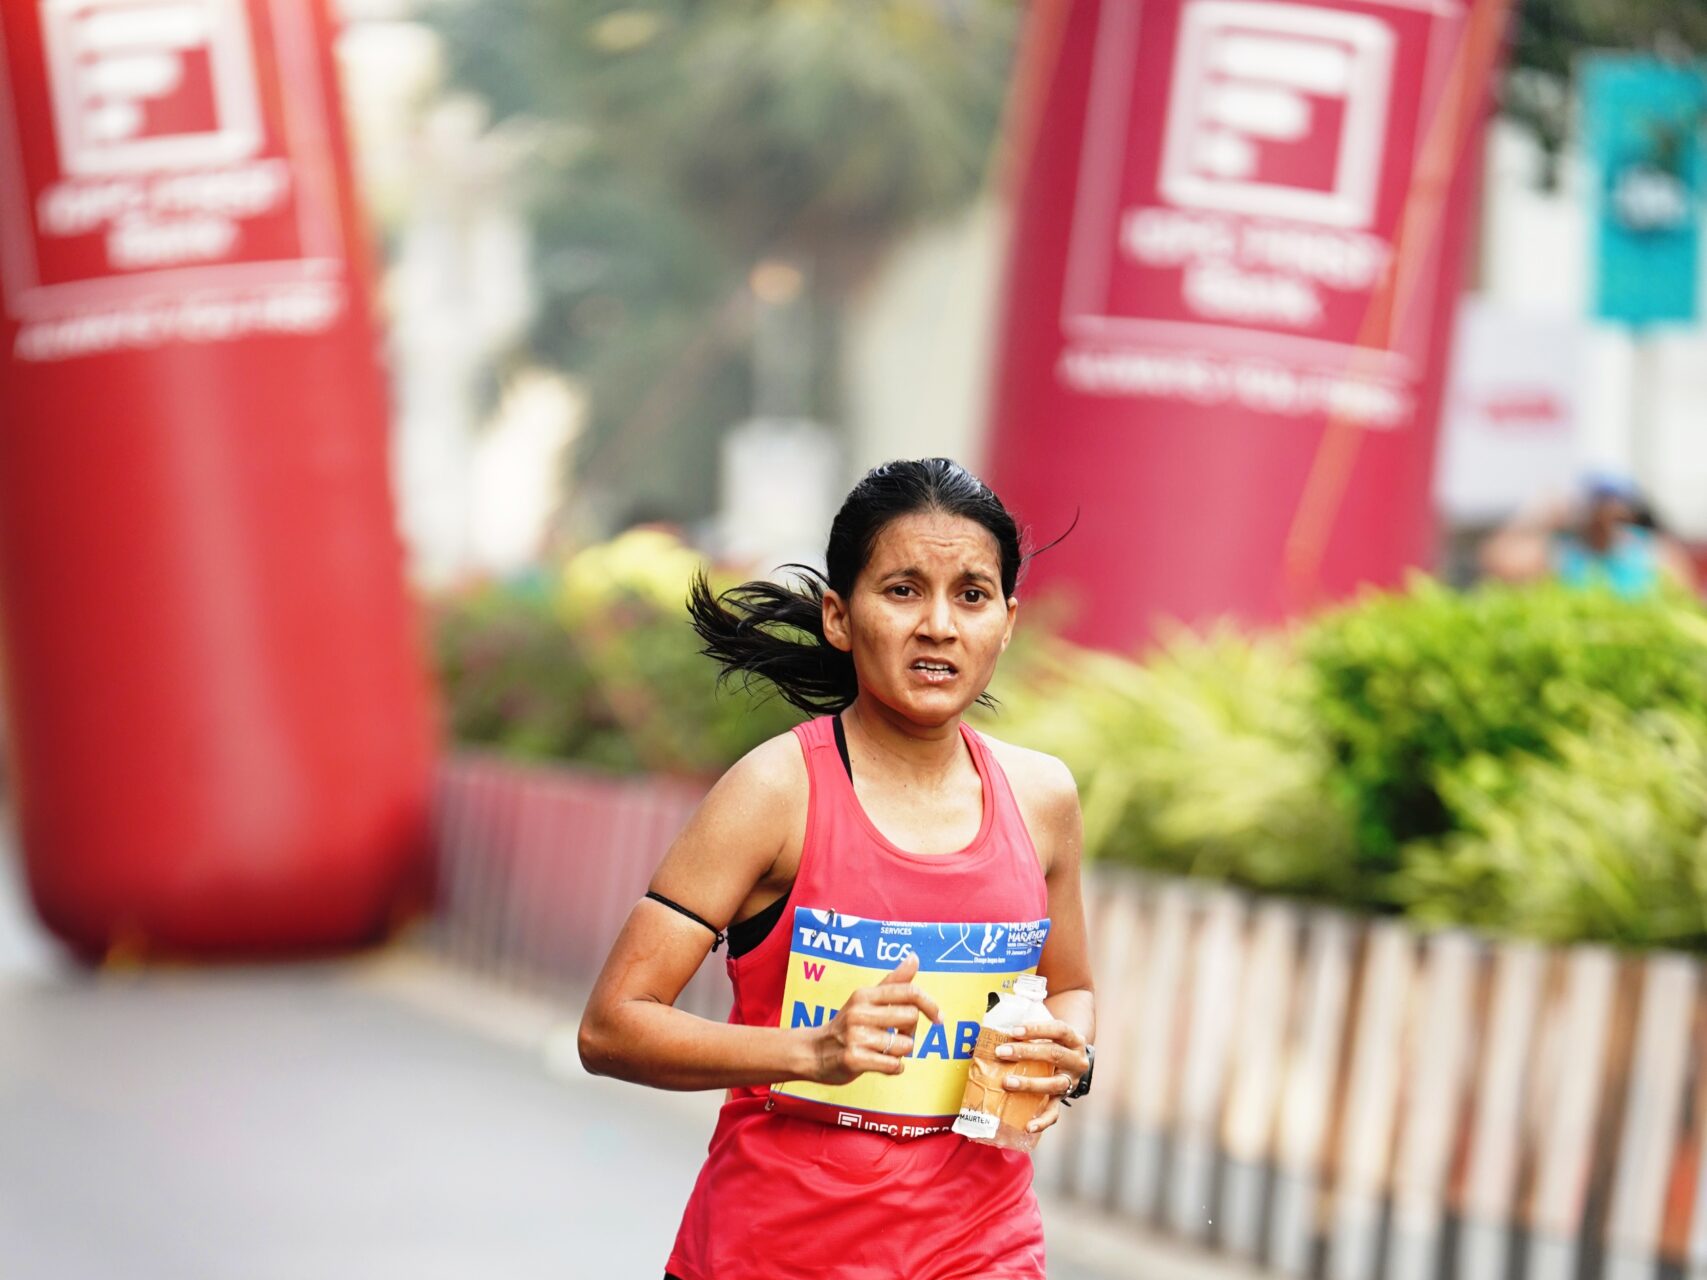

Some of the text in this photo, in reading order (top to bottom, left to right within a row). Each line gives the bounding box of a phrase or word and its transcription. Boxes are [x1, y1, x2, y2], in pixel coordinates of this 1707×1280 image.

[880, 926, 912, 935] SERVICES
[1007, 929, 1047, 943] MARATHON
[799, 927, 864, 958] TATA
[877, 937, 913, 961] tcs
[803, 961, 826, 982] W
[960, 1113, 991, 1125] MAURTEN
